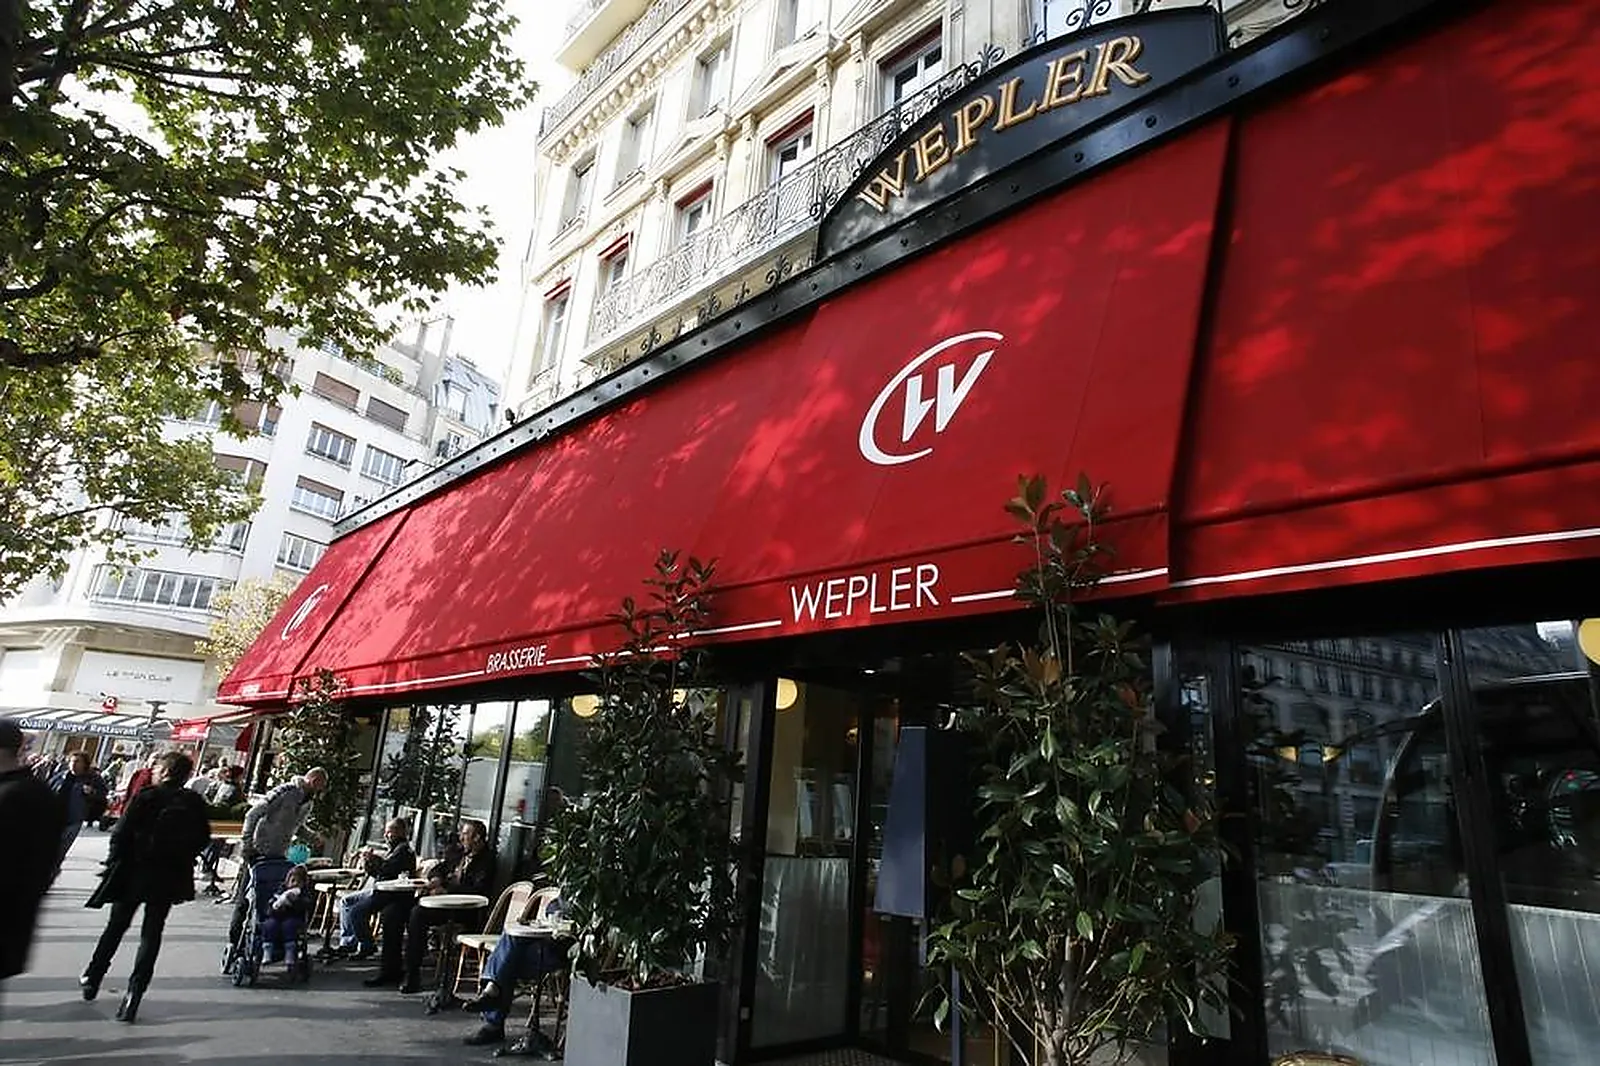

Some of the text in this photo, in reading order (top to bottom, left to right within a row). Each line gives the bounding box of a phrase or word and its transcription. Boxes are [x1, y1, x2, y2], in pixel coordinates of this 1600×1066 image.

[856, 35, 1152, 213] WEPLER
[789, 563, 940, 624] WEPLER
[486, 644, 547, 673] BRASSERIE
[19, 718, 138, 736] Quality Burger Restaurant
